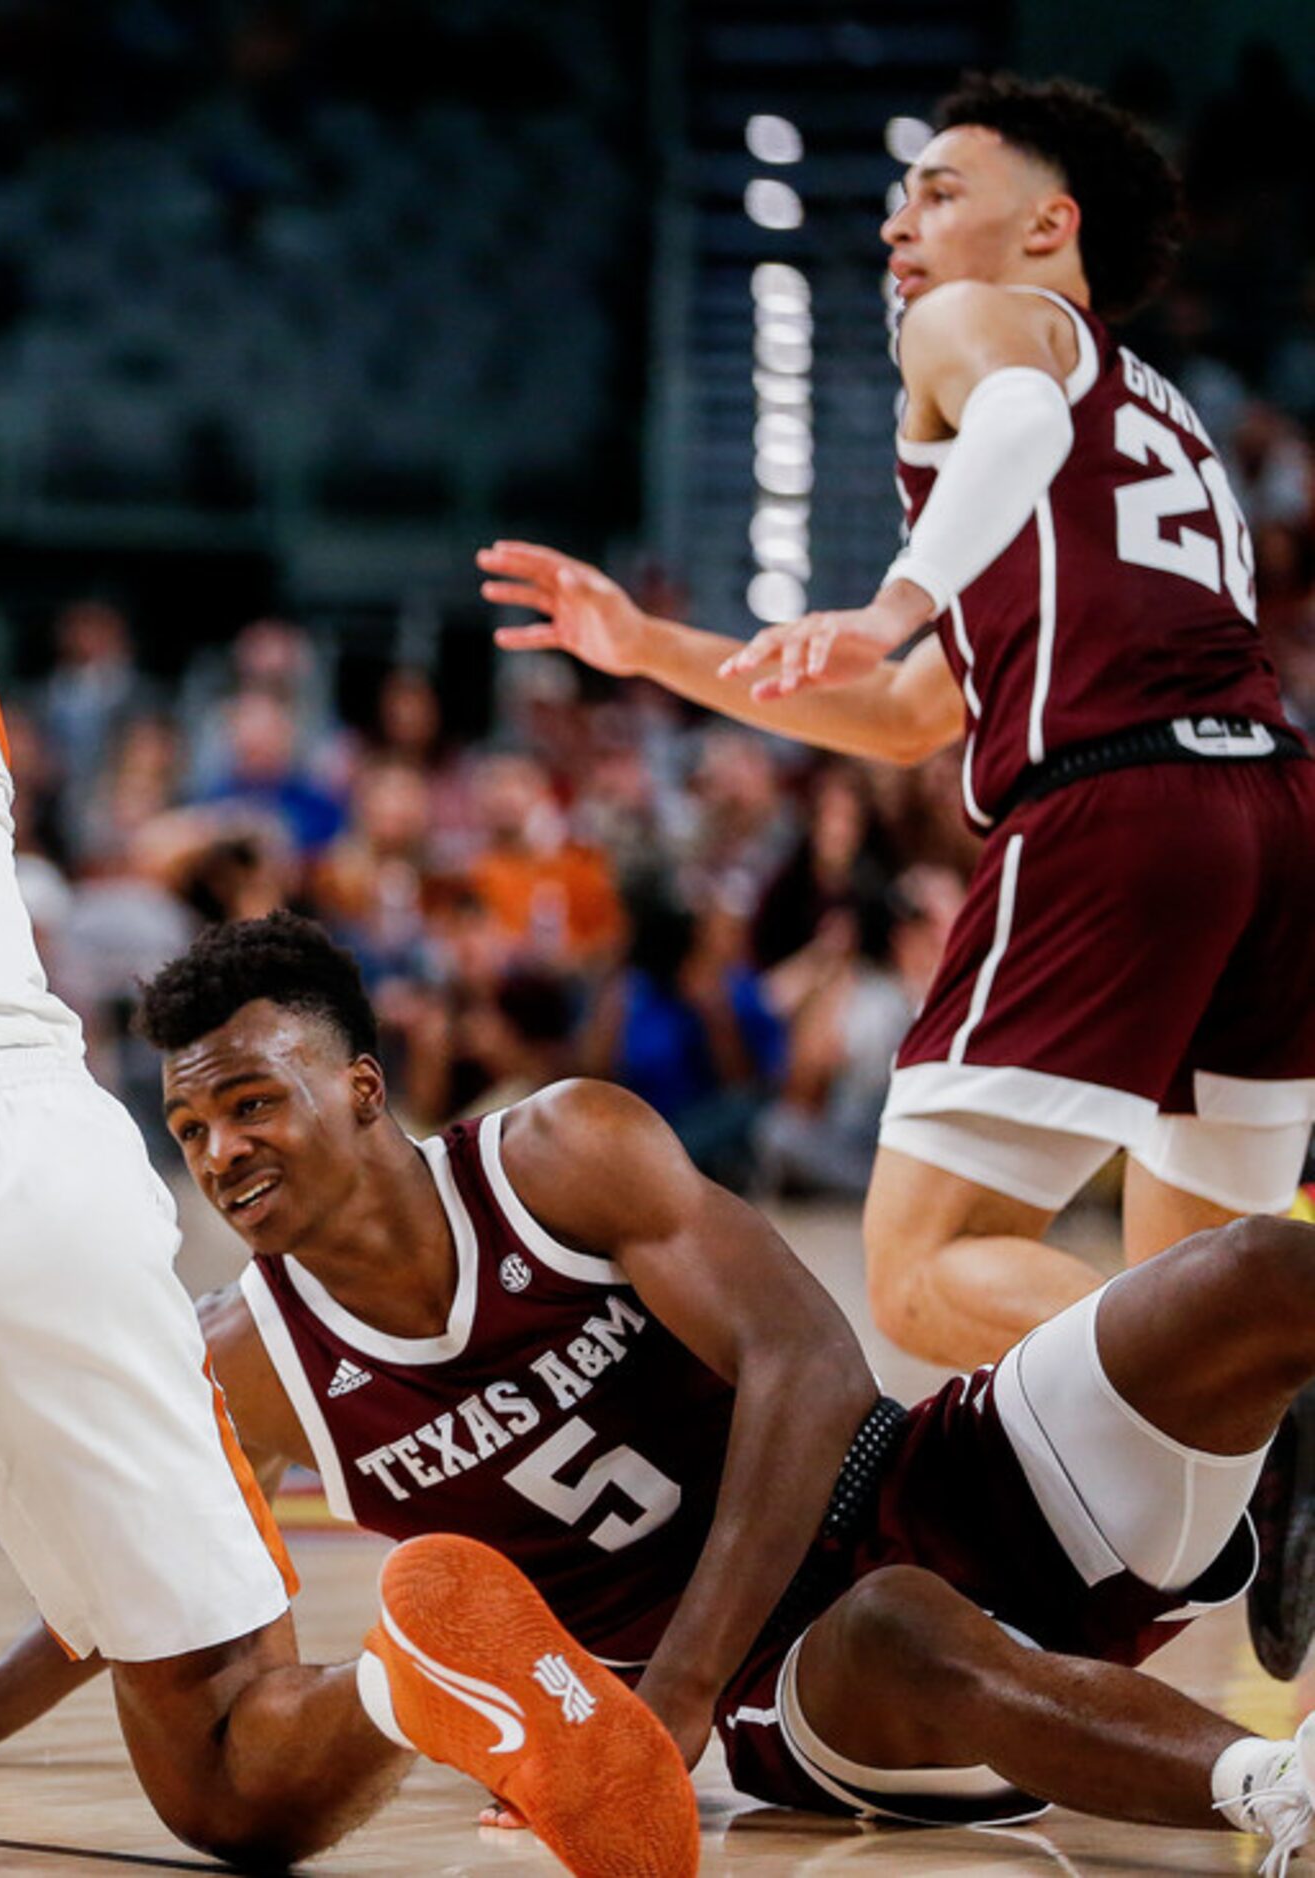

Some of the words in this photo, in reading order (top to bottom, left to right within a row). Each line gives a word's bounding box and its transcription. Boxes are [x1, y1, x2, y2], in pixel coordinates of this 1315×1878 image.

[355, 1381, 540, 1500] TEXAS
[530, 1296, 646, 1410] A&M
[502, 1415, 682, 1553] 5
